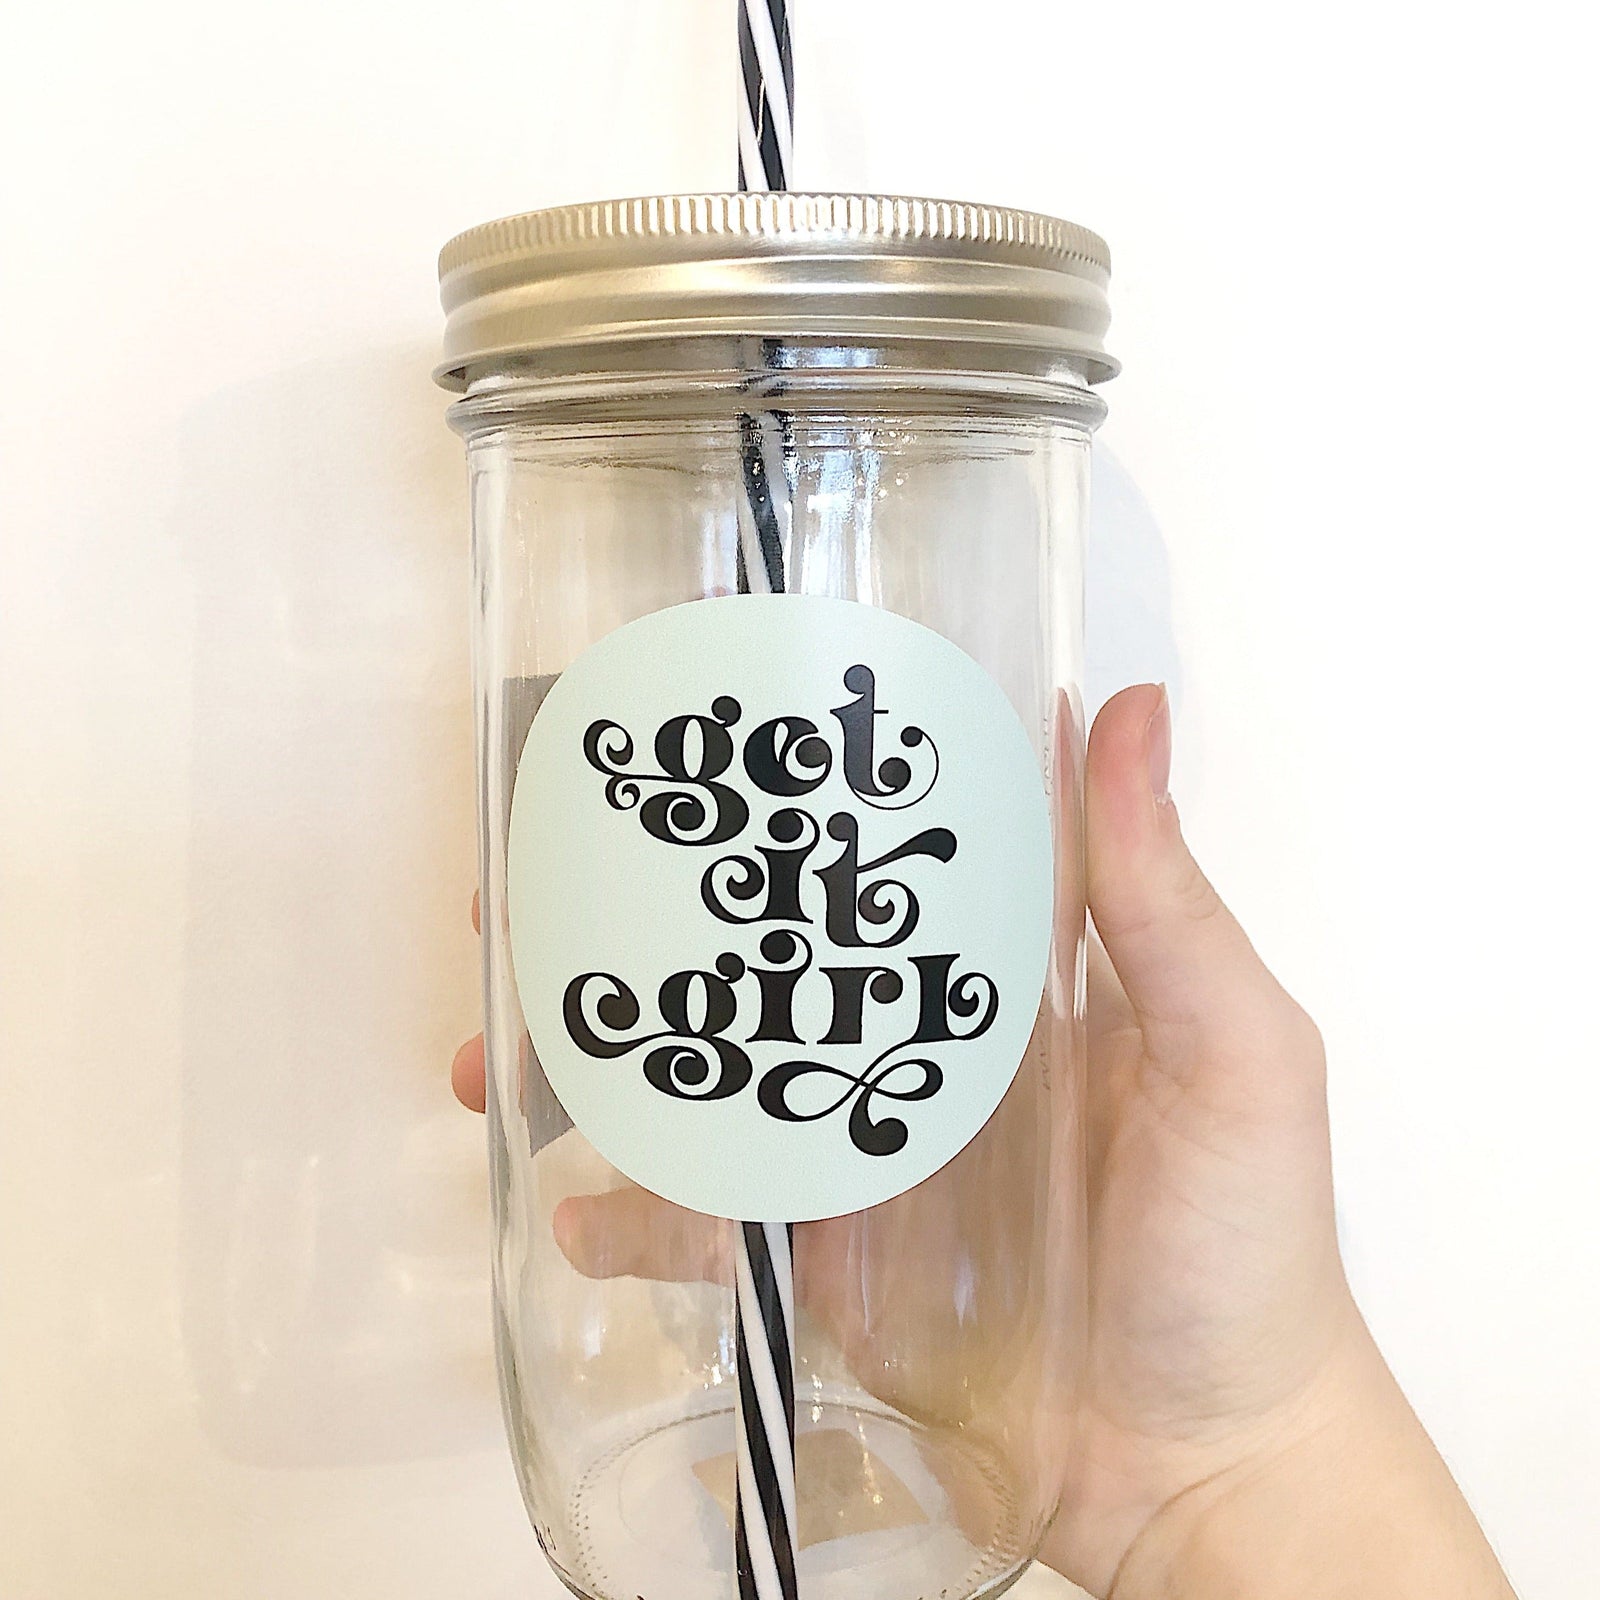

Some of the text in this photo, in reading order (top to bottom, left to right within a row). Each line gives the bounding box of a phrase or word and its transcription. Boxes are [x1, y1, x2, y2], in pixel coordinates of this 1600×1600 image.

[583, 664, 940, 846] get
[700, 807, 958, 948] it
[562, 929, 999, 1157] girl
